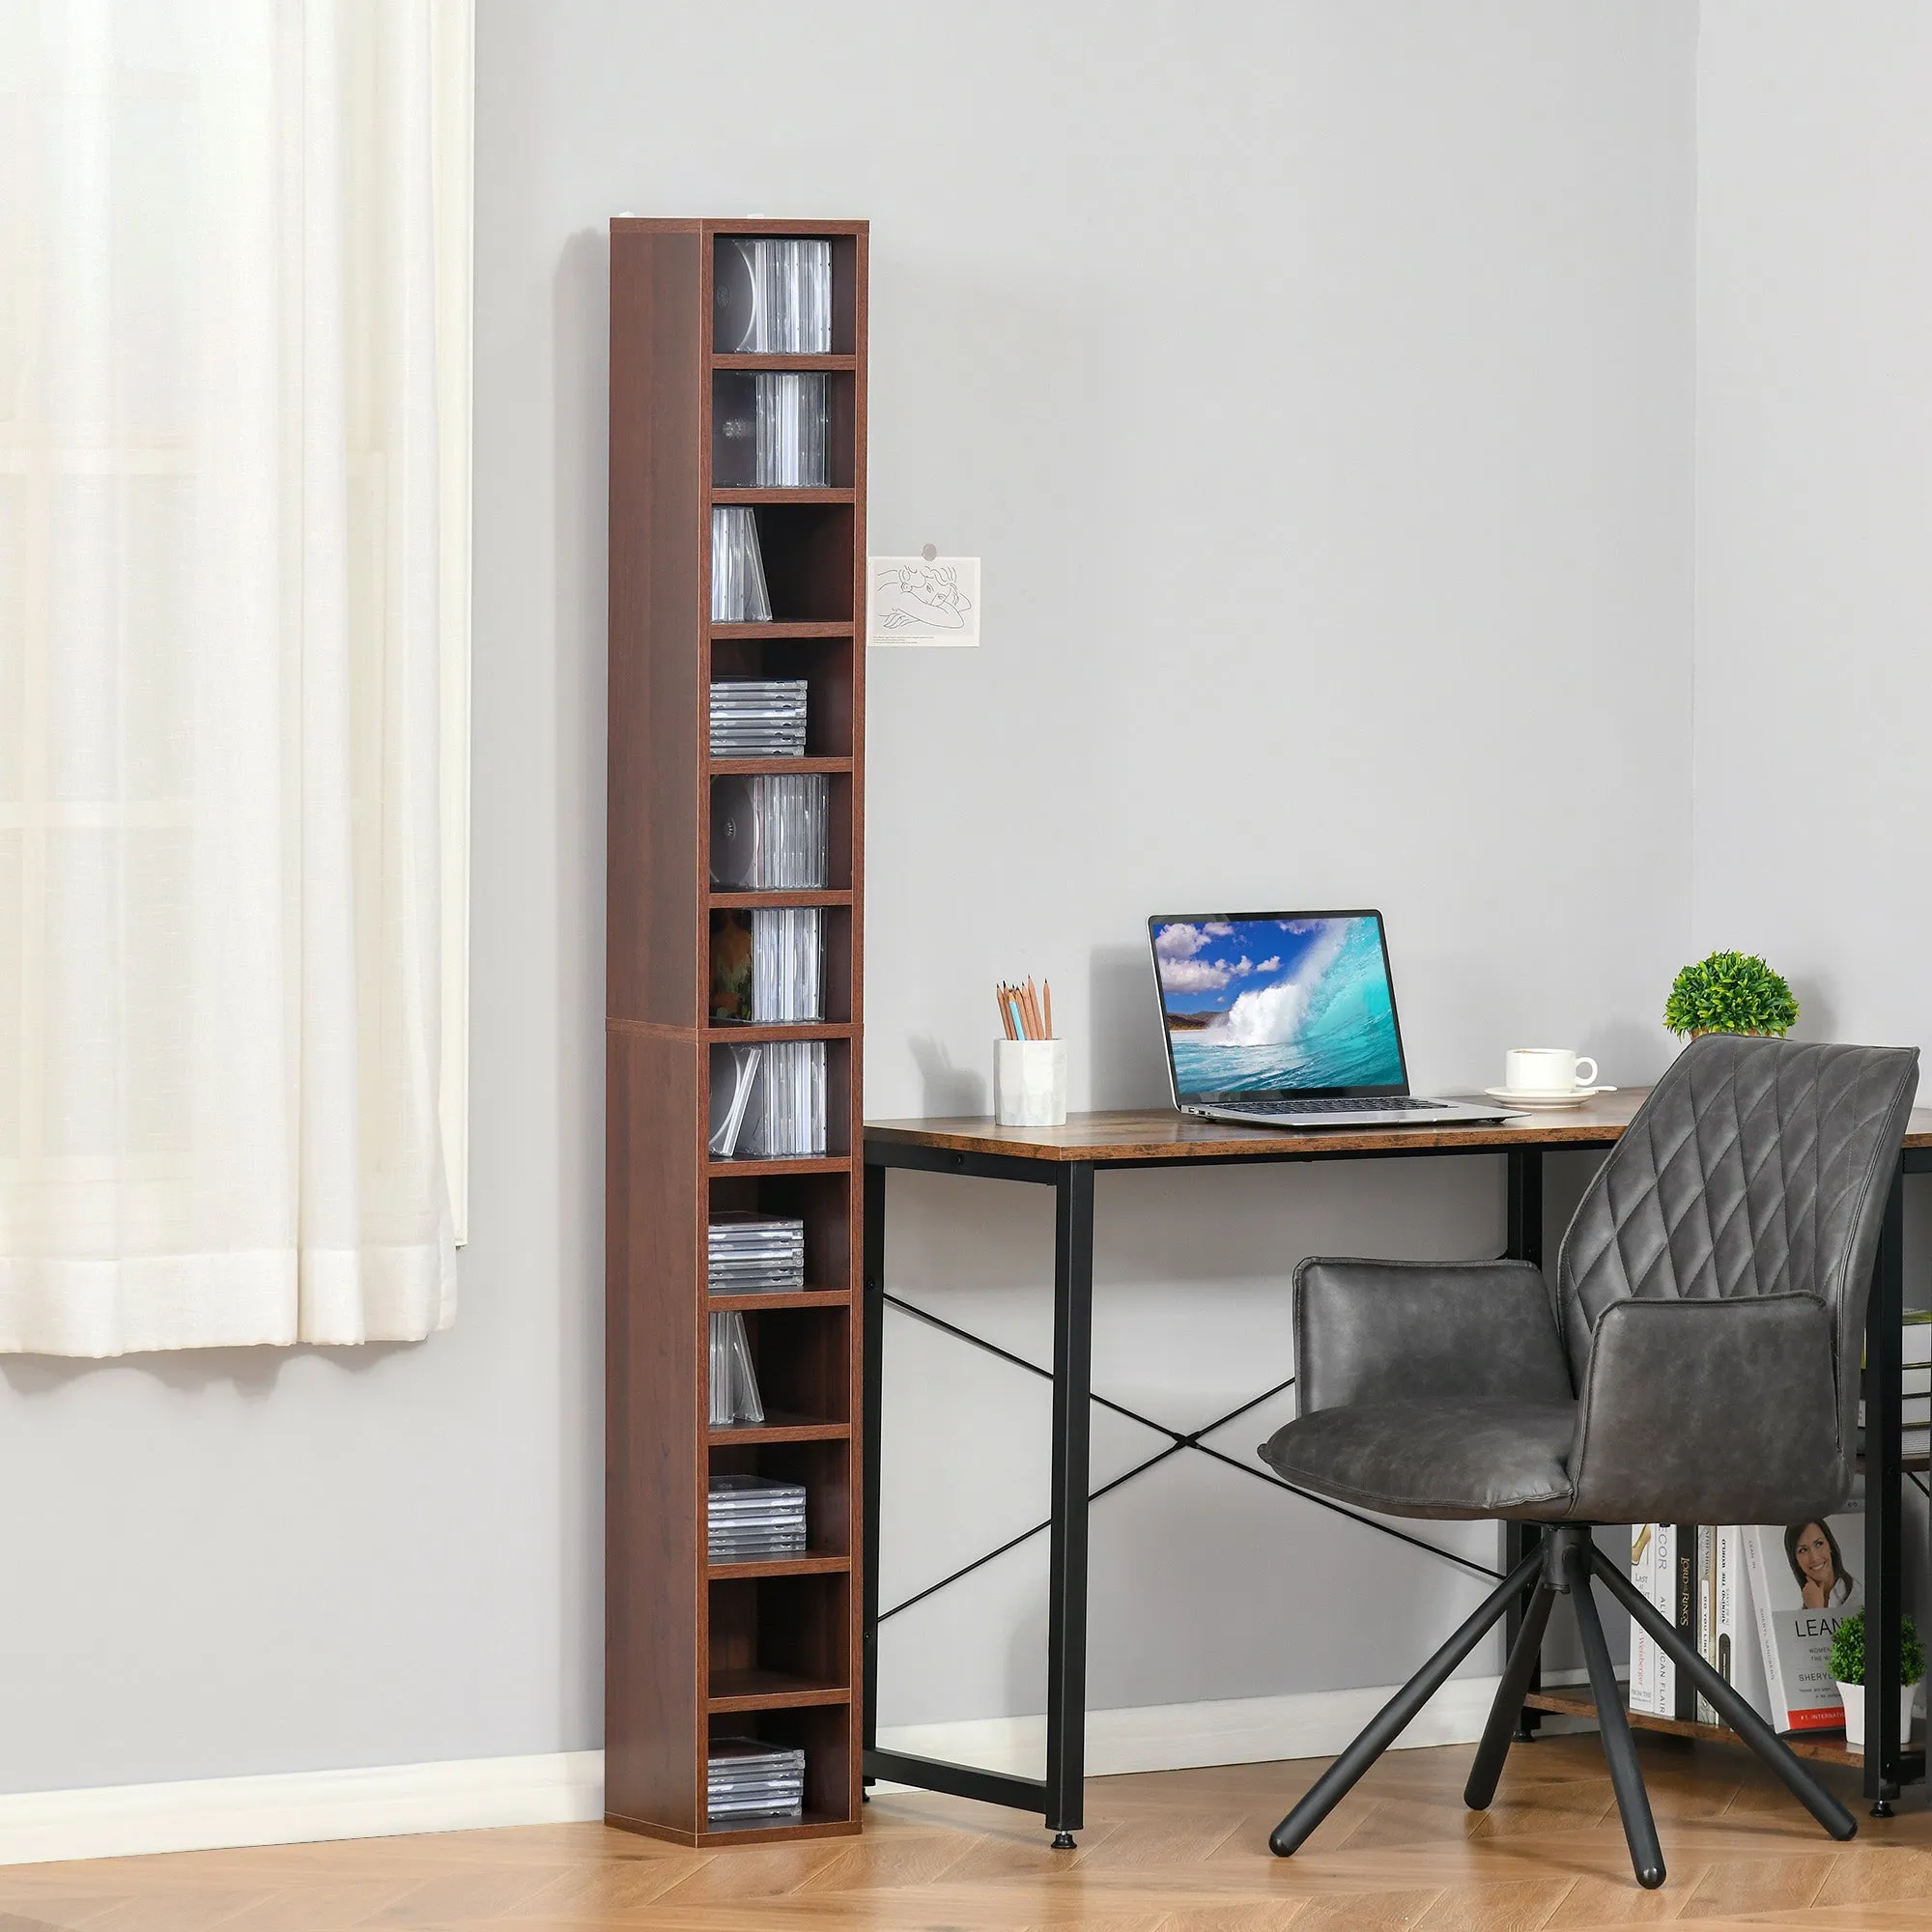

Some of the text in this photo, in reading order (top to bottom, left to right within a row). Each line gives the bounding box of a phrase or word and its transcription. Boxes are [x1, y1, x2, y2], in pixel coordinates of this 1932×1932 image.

[1659, 1526, 1667, 1570] ECOR
[1681, 1556, 1690, 1584] LORD
[1680, 1592, 1690, 1627] RINGS
[1794, 1617, 1843, 1637] LEAN
[1799, 1672, 1833, 1682] SHERYL
